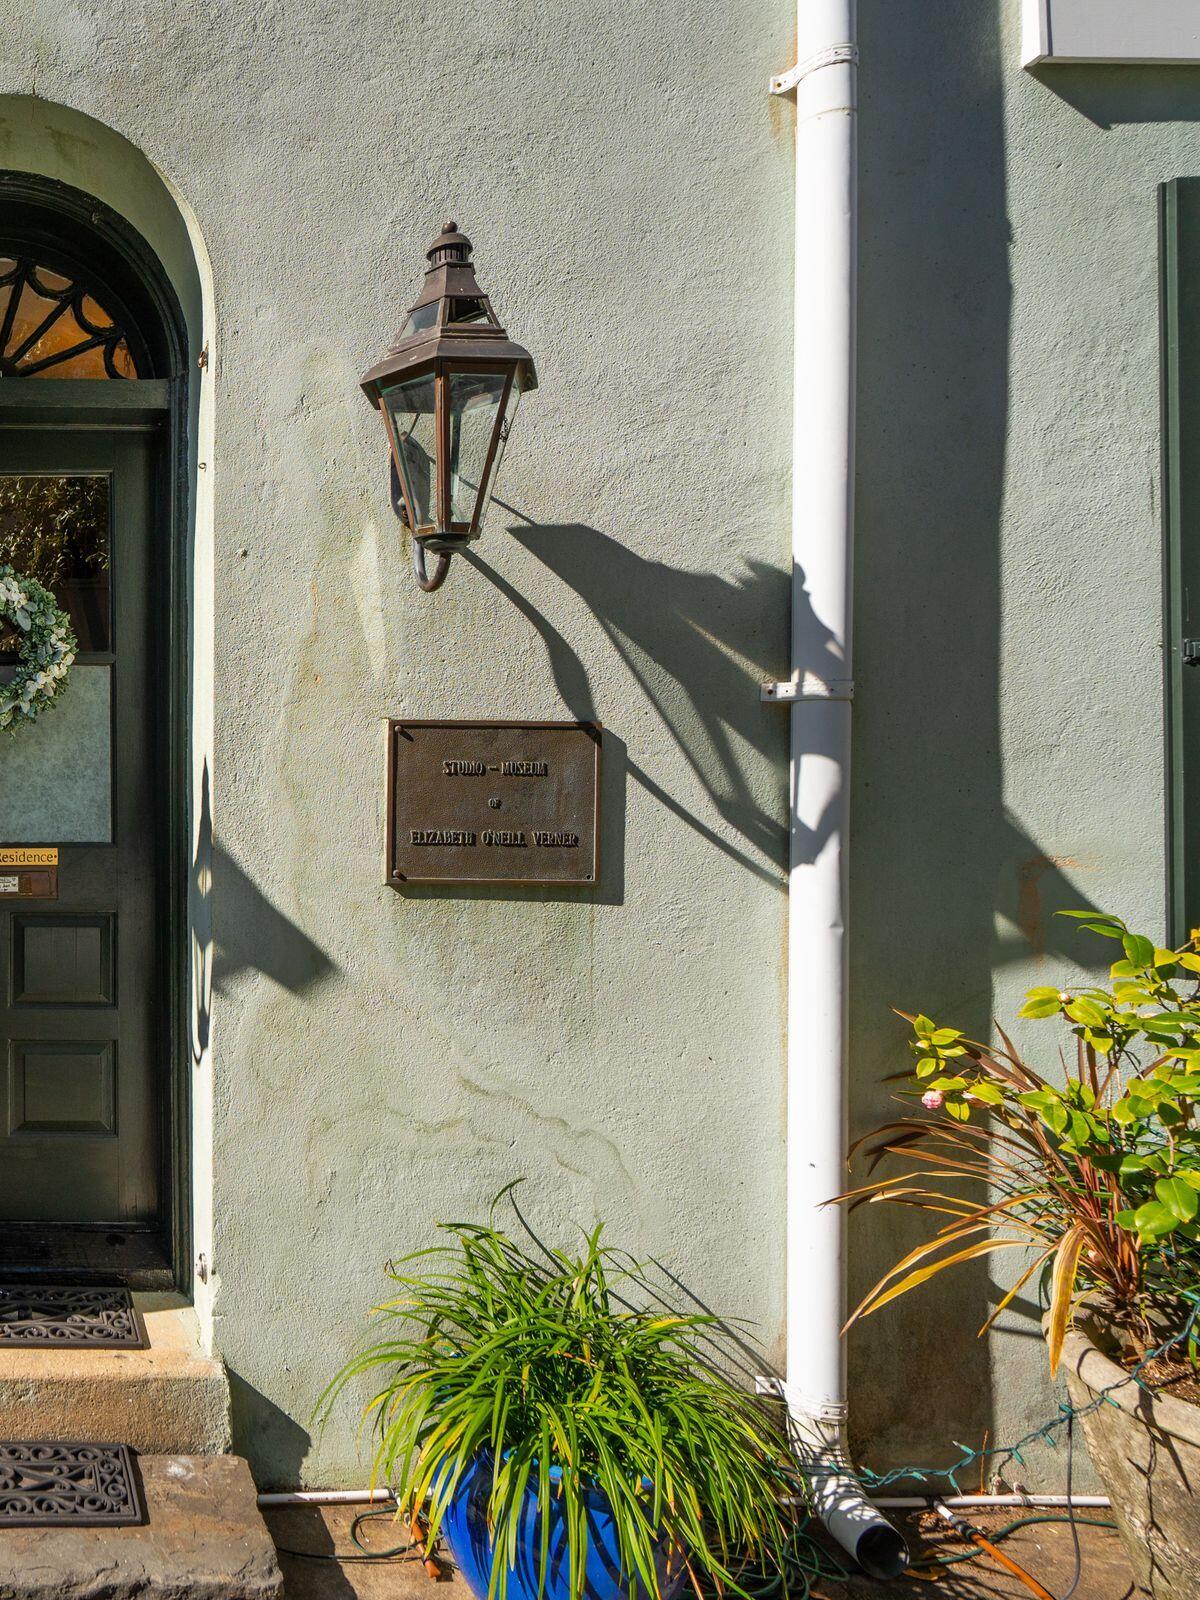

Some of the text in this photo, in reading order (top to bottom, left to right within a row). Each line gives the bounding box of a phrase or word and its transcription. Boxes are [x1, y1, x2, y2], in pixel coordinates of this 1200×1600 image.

[442, 760, 486, 776] STUDIO
[501, 760, 548, 776] MUSEUM
[410, 829, 578, 847] ELIZABETH O'NEILL VERNER
